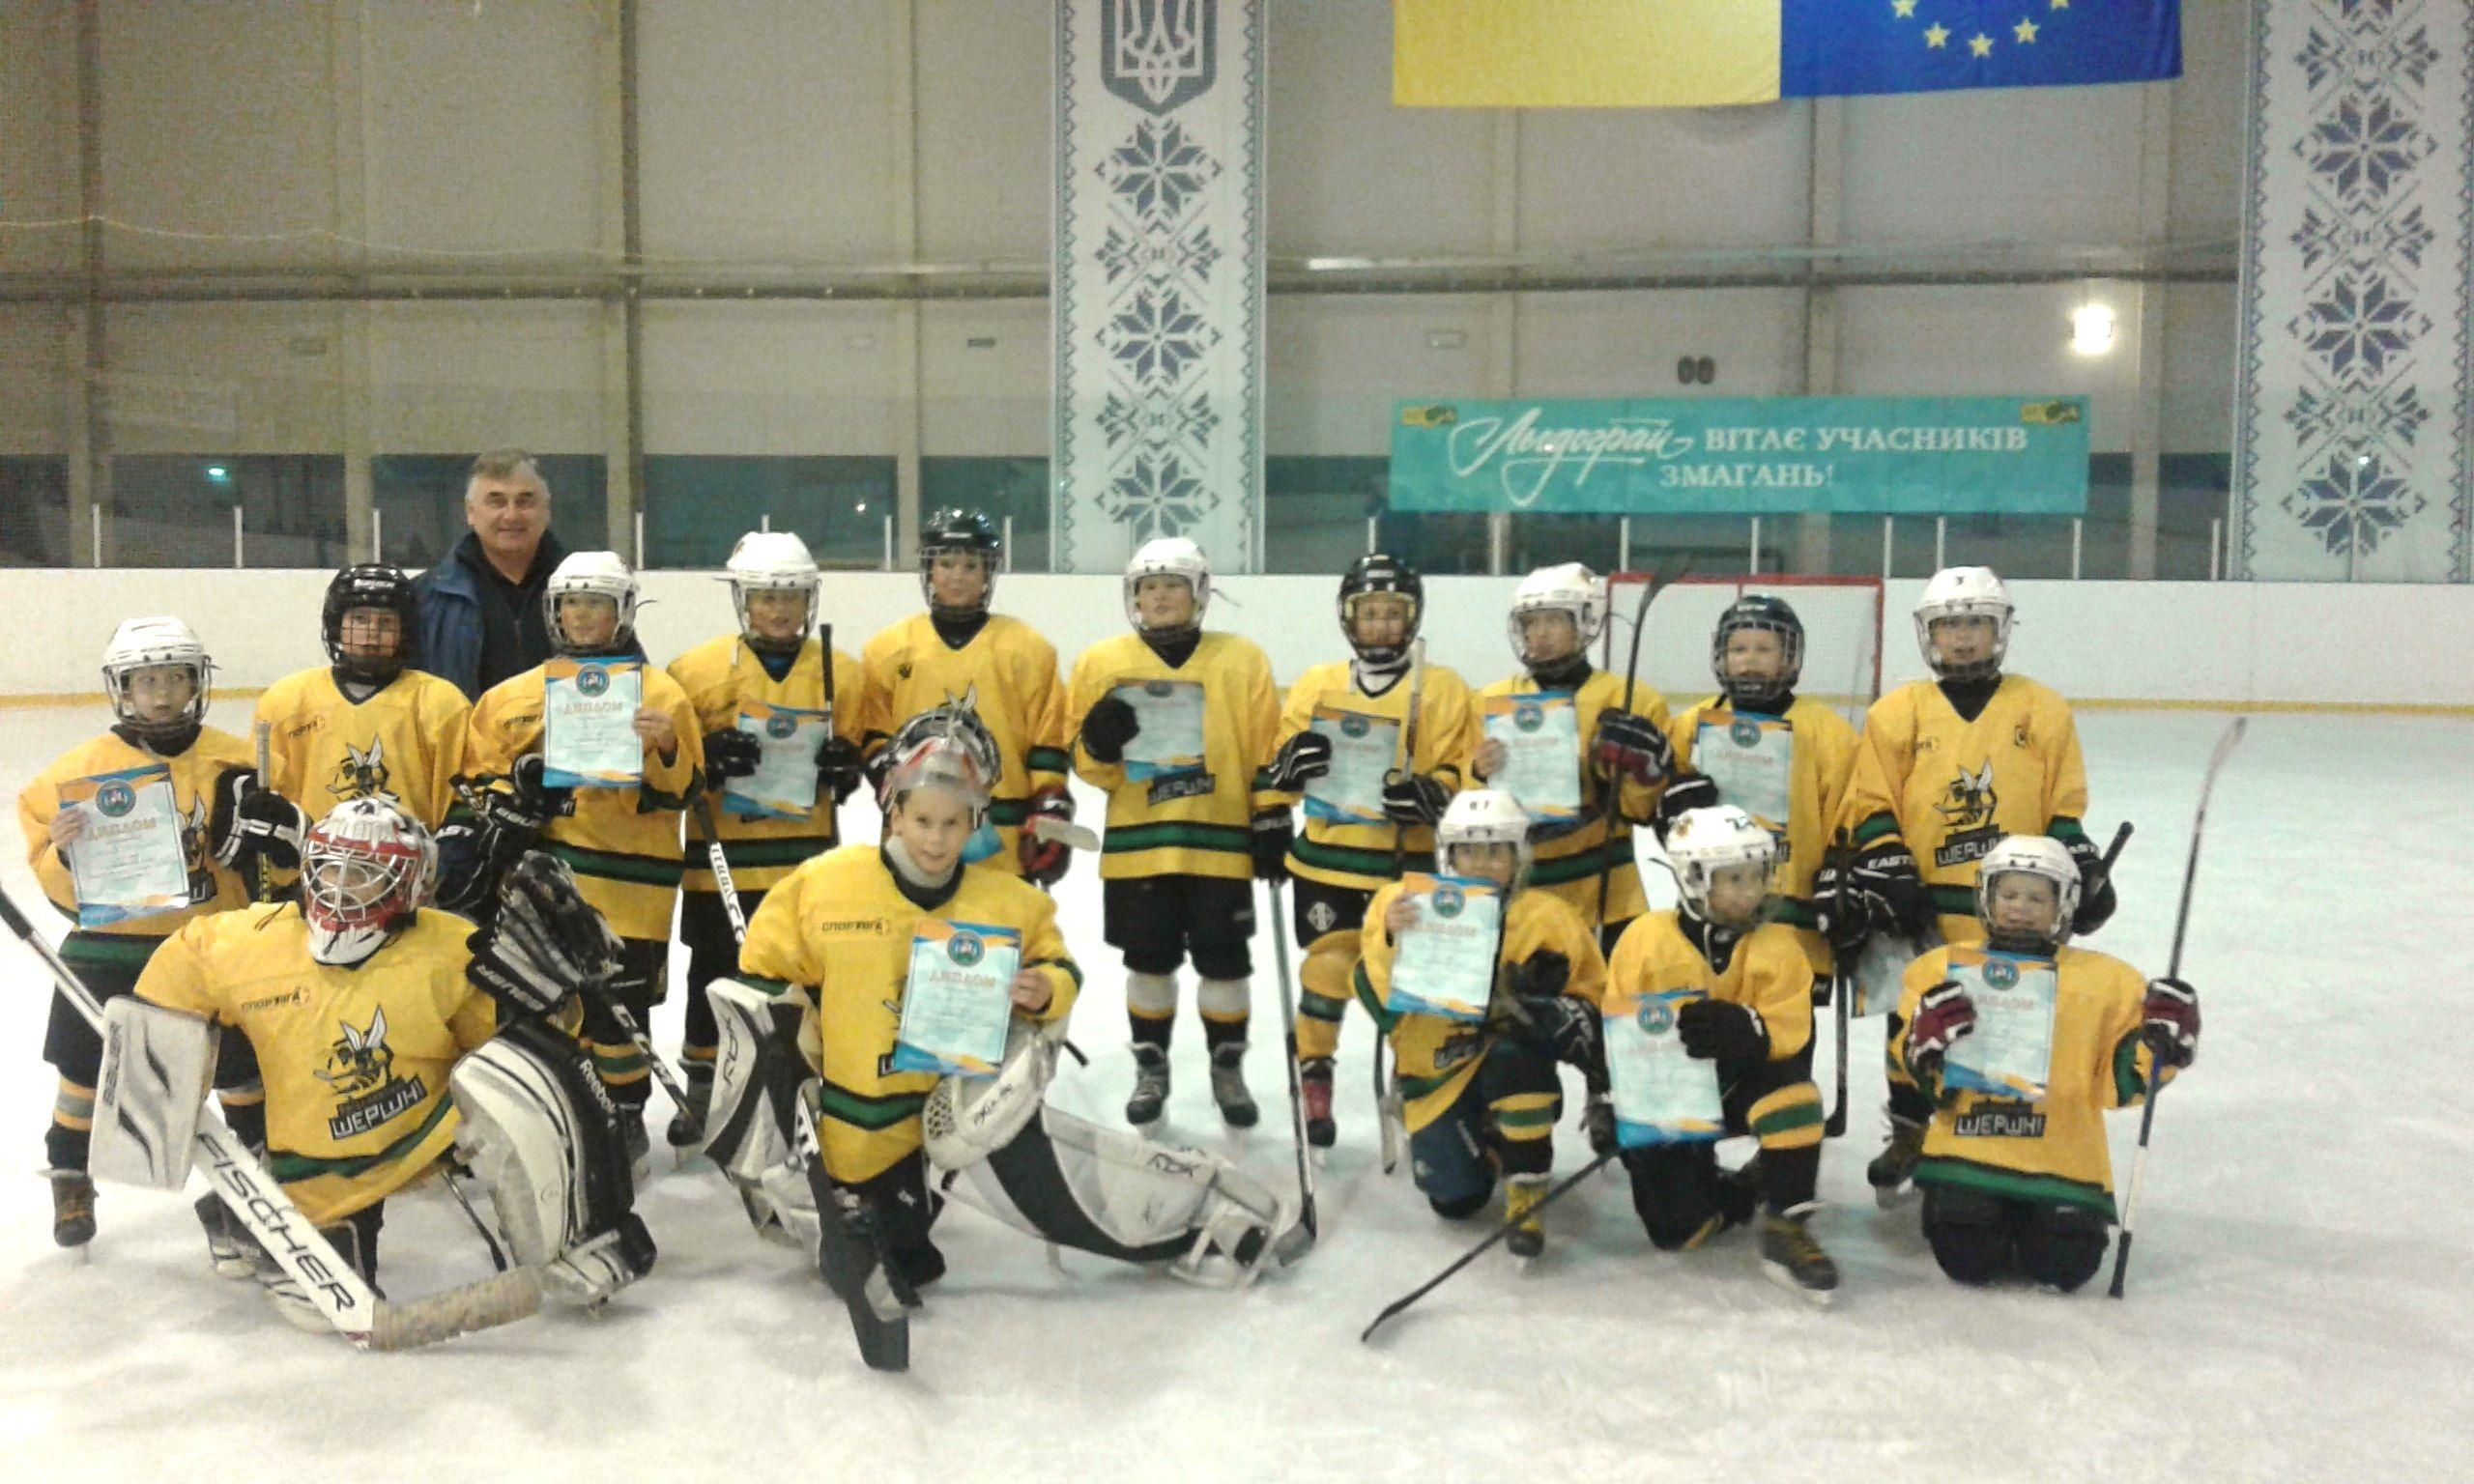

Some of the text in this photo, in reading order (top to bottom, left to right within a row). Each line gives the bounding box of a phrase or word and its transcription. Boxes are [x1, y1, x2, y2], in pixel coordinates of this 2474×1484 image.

[1705, 427, 1805, 451] ВІТАЄ
[1818, 425, 2028, 451] УЧАСНИКІВ
[331, 1078, 424, 1139] ШЕРШНІ
[195, 1133, 356, 1313] FISCHER
